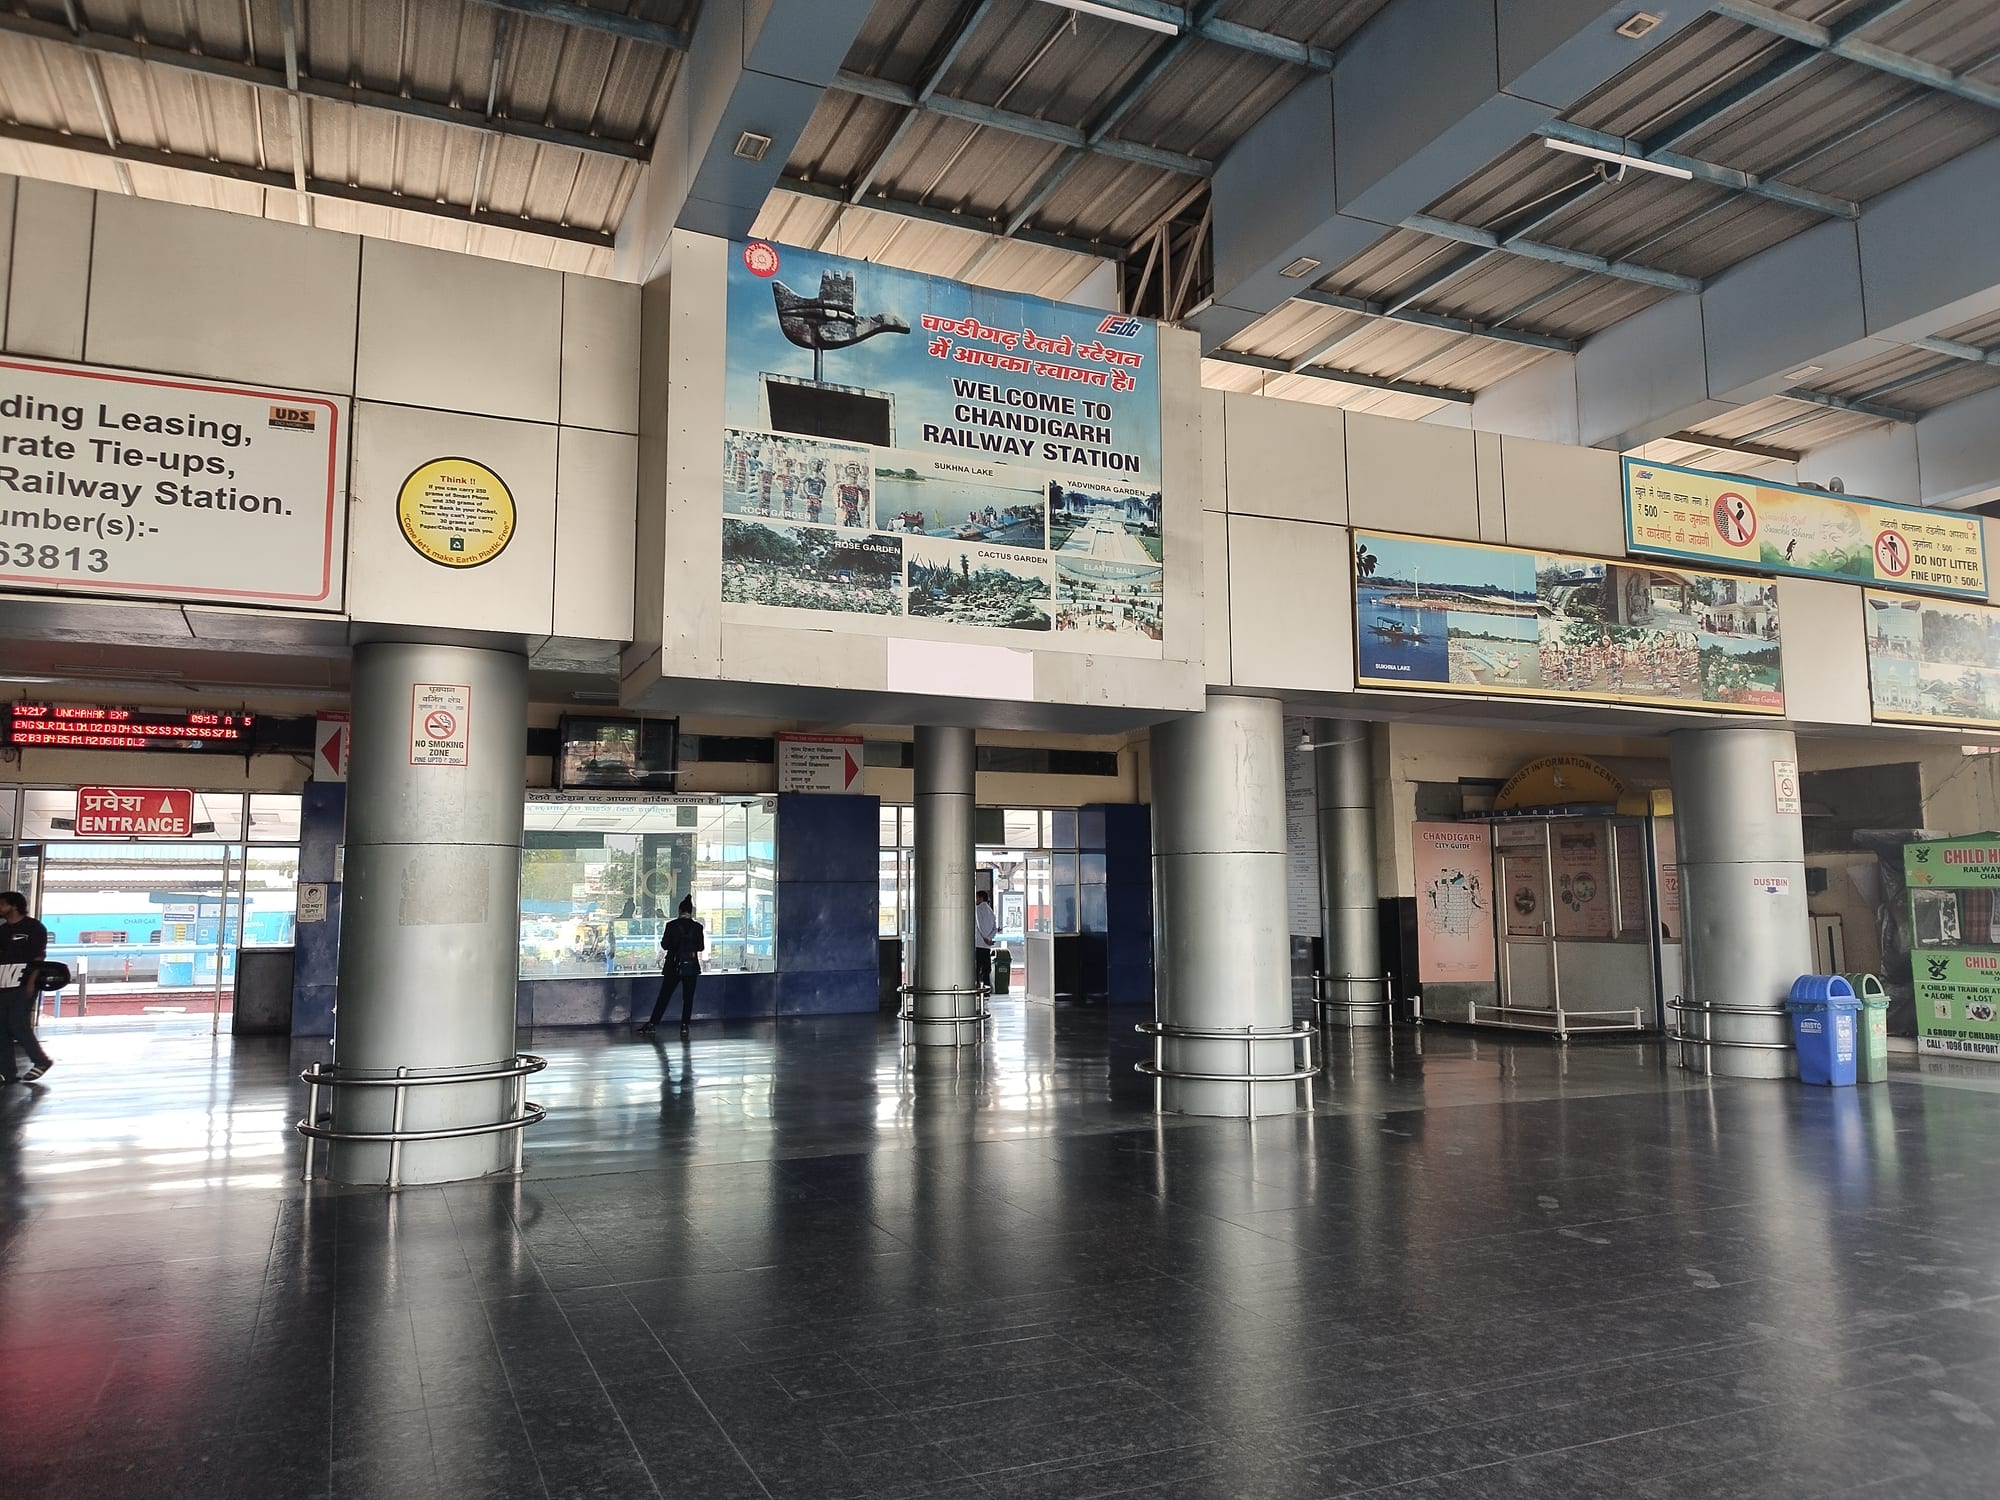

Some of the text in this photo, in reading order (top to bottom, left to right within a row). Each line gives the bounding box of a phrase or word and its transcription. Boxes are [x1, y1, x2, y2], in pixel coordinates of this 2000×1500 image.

[921, 314, 1144, 368] चण्डीगढ़ रेलवे स्टेशन
[928, 336, 953, 359] में
[953, 347, 1032, 374] आपका
[1033, 360, 1109, 386] स्वागत
[952, 378, 1112, 421] WELCOME TO
[0, 394, 252, 447] ding Leasing,
[275, 407, 310, 422] UDS
[954, 404, 1111, 445] CHANDIGARH
[923, 423, 1141, 473] RAILWAY STATION
[2, 434, 235, 480] rate Tie-ups,
[934, 462, 994, 477] SUKHNA LAKE
[440, 475, 467, 485] Think
[1067, 480, 1146, 497] YADVINDRA GARDEN
[154, 480, 292, 516] Station.
[740, 505, 812, 521] ROCK GARDEN
[1644, 504, 1658, 518] 500
[1673, 511, 1686, 522] तक
[1637, 526, 1643, 537] व
[1675, 528, 1685, 543] की
[431, 550, 455, 563] make
[455, 555, 479, 564] Earth
[478, 541, 502, 560] Plastic
[834, 540, 901, 555] ROSE GARDEN
[1942, 544, 1953, 553] 500
[977, 550, 1048, 564] CACTUS GARDEN
[1914, 554, 1978, 572] DO NOT LITTER
[1911, 570, 1983, 587] FINE UPTO 500/-
[1397, 664, 1411, 672] LAKE
[14, 706, 48, 717] 14217
[55, 708, 105, 719] UNCHAHAR
[110, 710, 129, 720] EXP
[225, 716, 232, 725] A
[244, 717, 251, 726] 5
[15, 720, 34, 729] ENG
[36, 721, 55, 730] SLR
[415, 740, 464, 749] NO SMOKING
[429, 749, 450, 757] ZONE
[1500, 757, 1592, 801] TOURIST INFORMATION
[83, 789, 145, 812] प्रवेश
[81, 816, 185, 833] ENTRANCE
[1423, 832, 1482, 842] CHANDIGARH
[1943, 848, 1985, 865] CHILD
[1753, 878, 1788, 887] DUSTBIN
[1965, 956, 1998, 969] CHILD
[1931, 992, 1954, 1000] ALONE
[1973, 994, 1993, 1002] LOST
[1933, 1029, 1957, 1037] GROUP
[1926, 1039, 1999, 1054] CALL 1098 OR REPORT
